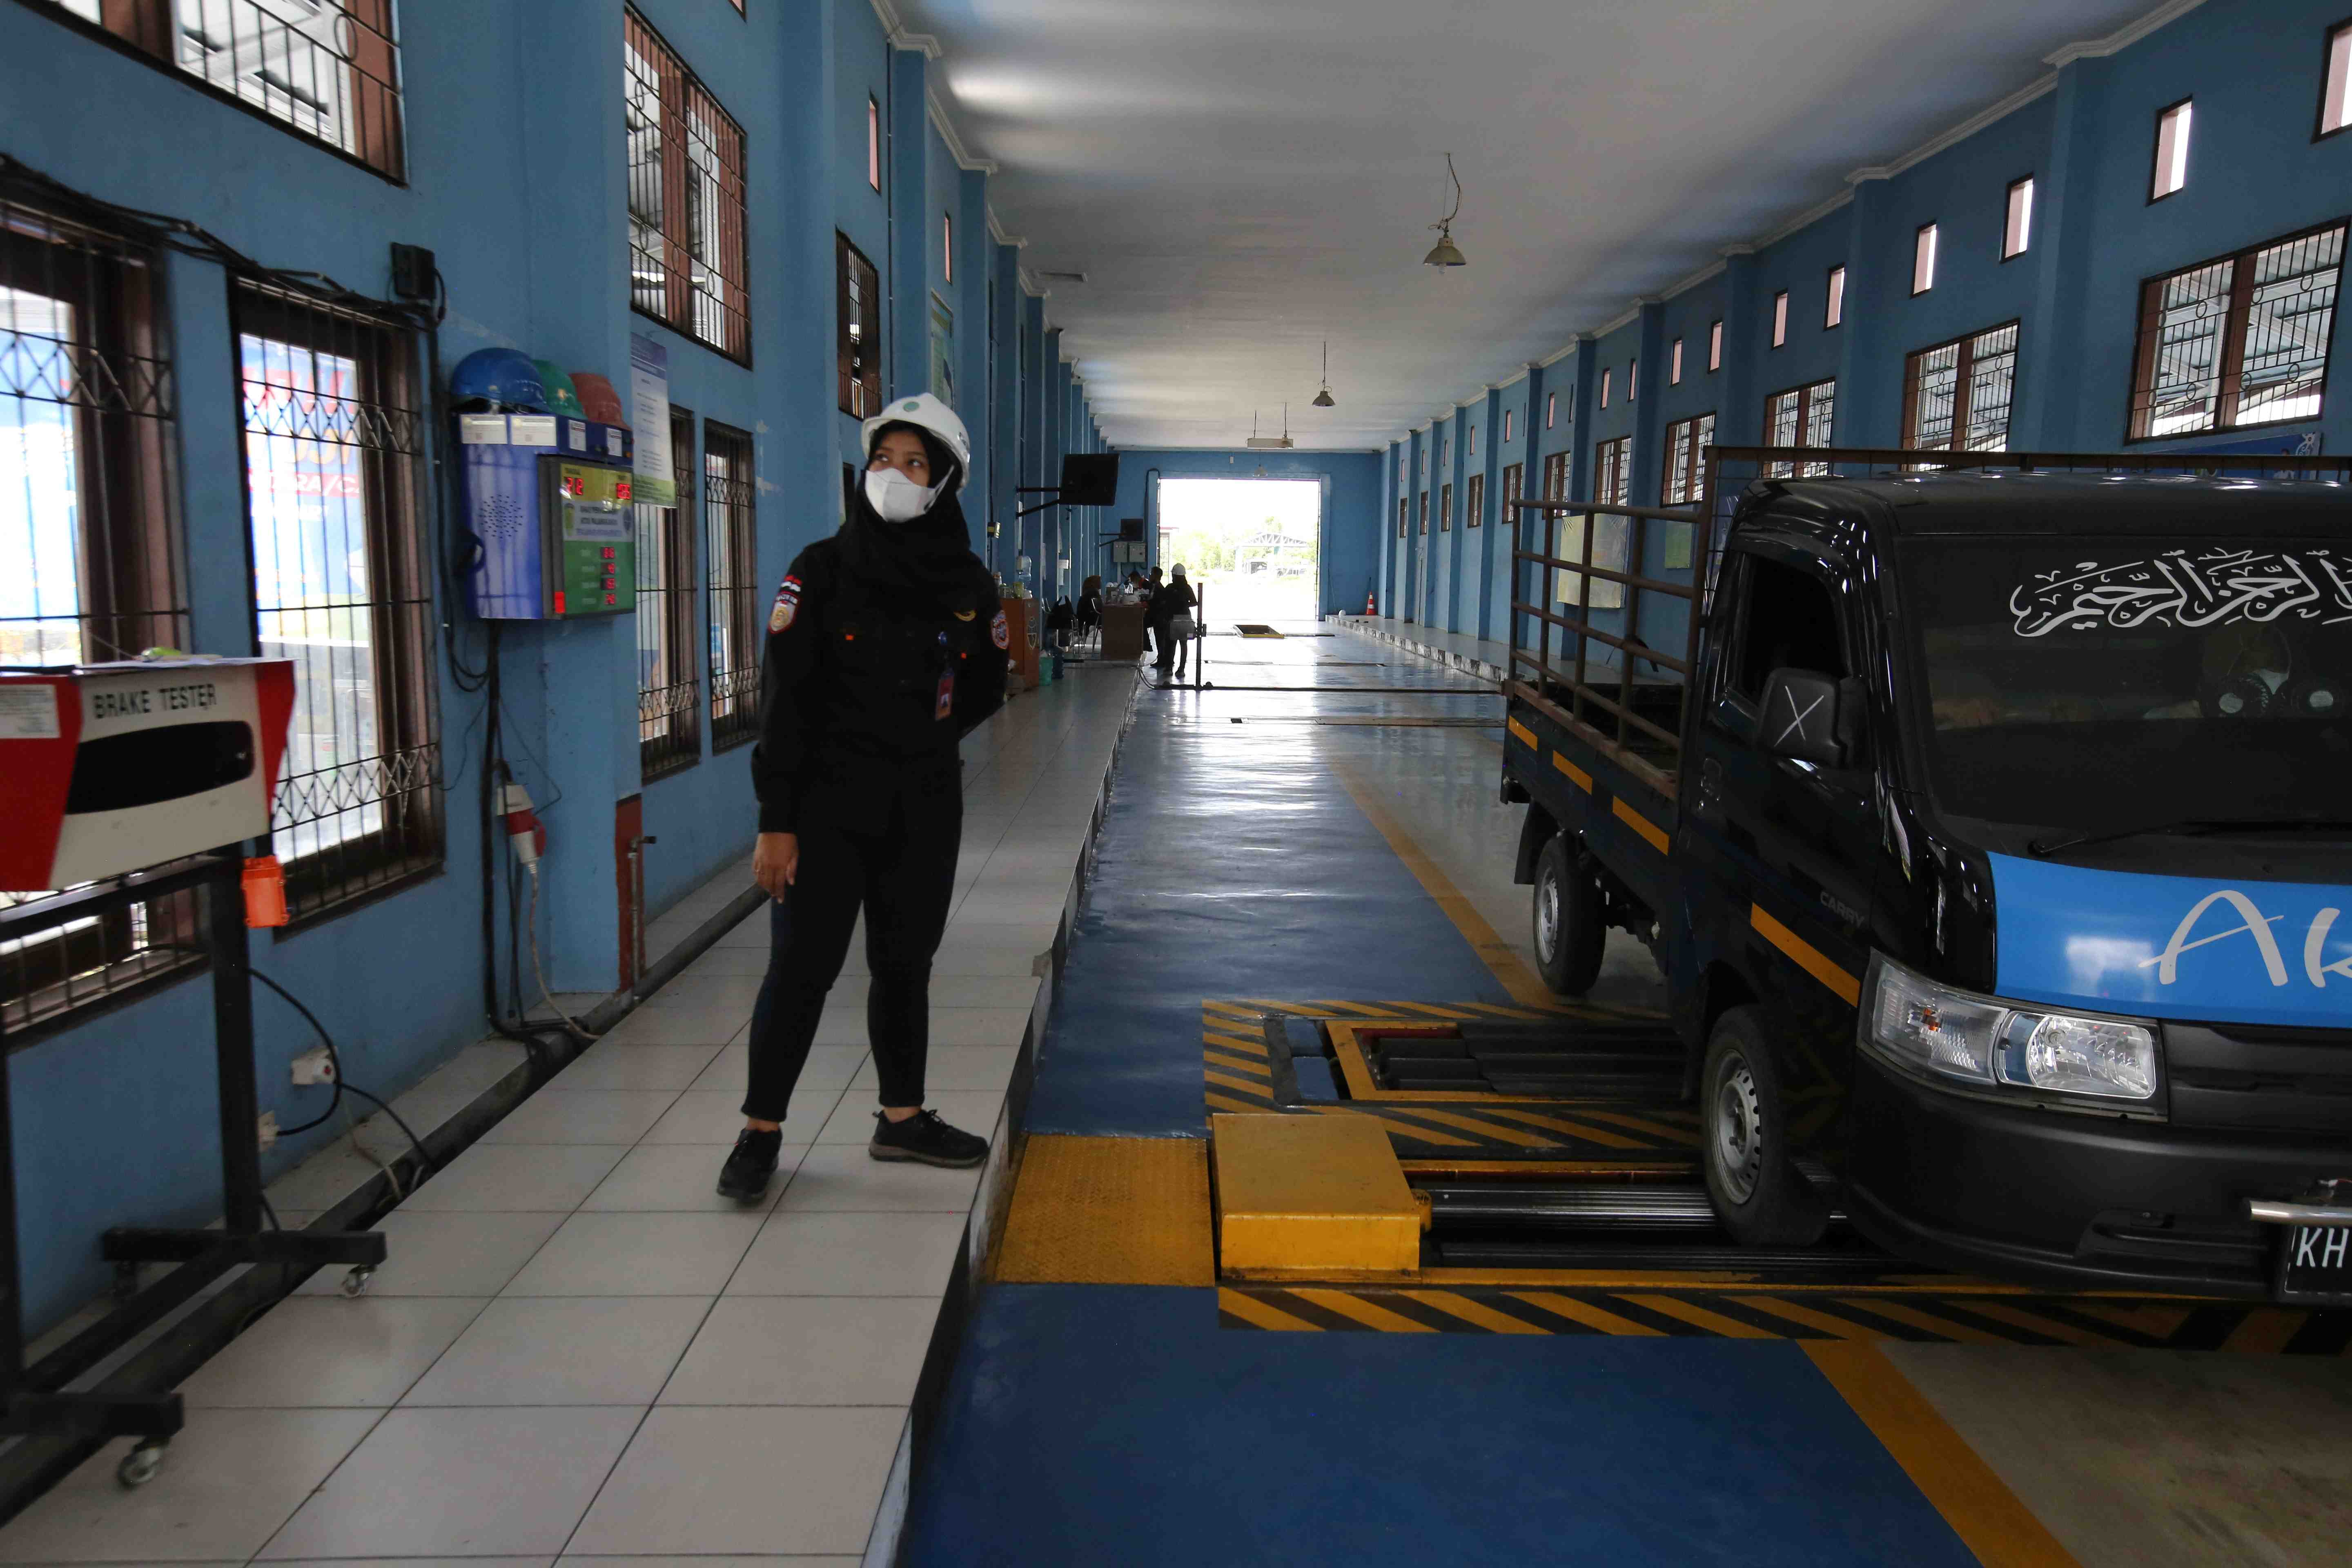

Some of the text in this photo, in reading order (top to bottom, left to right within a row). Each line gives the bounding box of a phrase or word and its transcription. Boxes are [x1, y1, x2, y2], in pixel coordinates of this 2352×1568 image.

[92, 684, 217, 719] BRAKE TESTER
[1820, 891, 1865, 928] CARRY
[2296, 1227, 2349, 1268] KH
